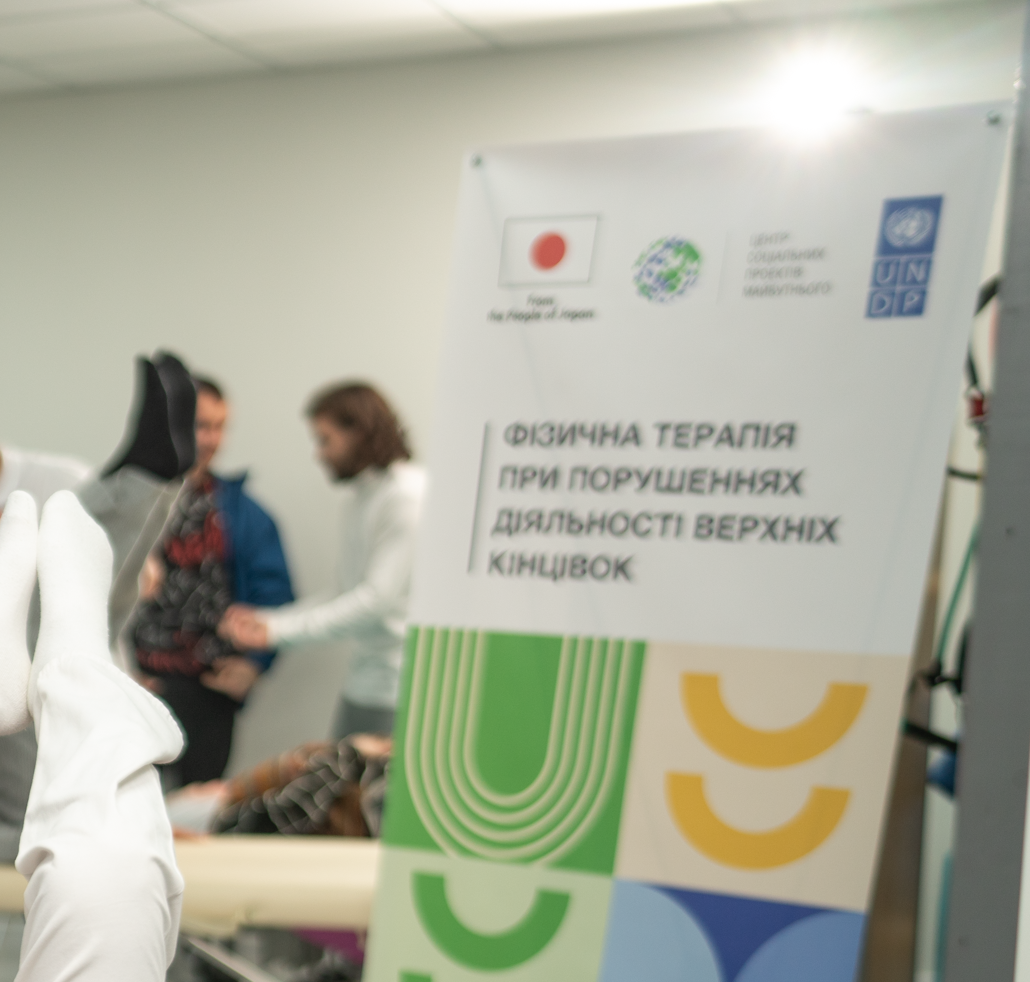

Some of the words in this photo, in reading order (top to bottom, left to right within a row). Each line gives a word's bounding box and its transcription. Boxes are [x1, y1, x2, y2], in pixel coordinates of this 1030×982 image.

[506, 307, 542, 323] People
[544, 304, 558, 319] of
[559, 307, 596, 321] Japan
[526, 293, 555, 306] From
[503, 421, 643, 449] ФІЗИЧНА
[653, 421, 798, 449] ТЕРАПІЯ
[497, 465, 561, 491] ПРИ
[568, 465, 806, 495] ПОРУШЕННЯХ
[491, 508, 685, 538] ДІЯЛЬНОСТІ
[692, 513, 842, 544] ВЕРХНІХ
[486, 550, 636, 582] КІНЦІВОК
